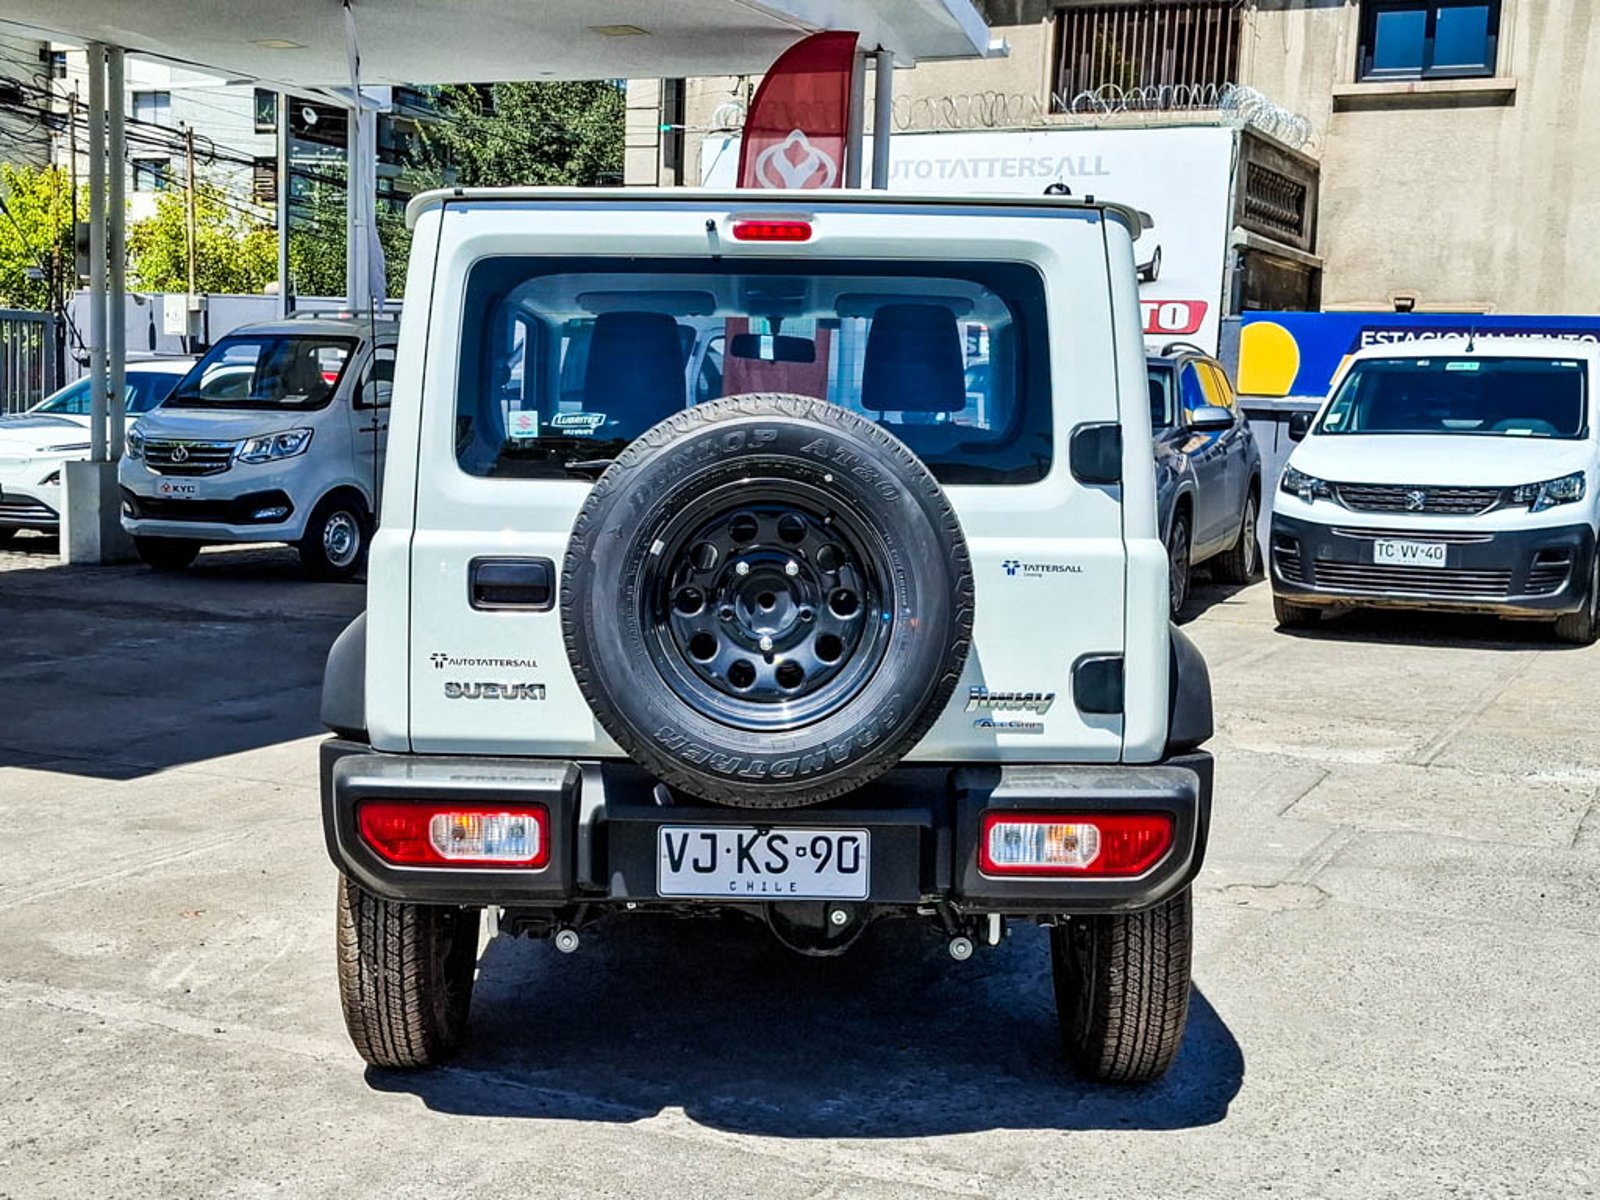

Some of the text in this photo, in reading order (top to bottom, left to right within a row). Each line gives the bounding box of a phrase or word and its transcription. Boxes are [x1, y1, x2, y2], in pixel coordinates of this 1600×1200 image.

[863, 155, 1110, 179] UTOTATTERSALL
[172, 485, 196, 493] KYC
[1023, 564, 1083, 573] TATTERSALL
[448, 658, 538, 668] AUTOTATTERSALL
[444, 681, 546, 700] SUZUKI
[653, 692, 901, 779] GRANDTREK
[729, 880, 797, 892] CHILE
